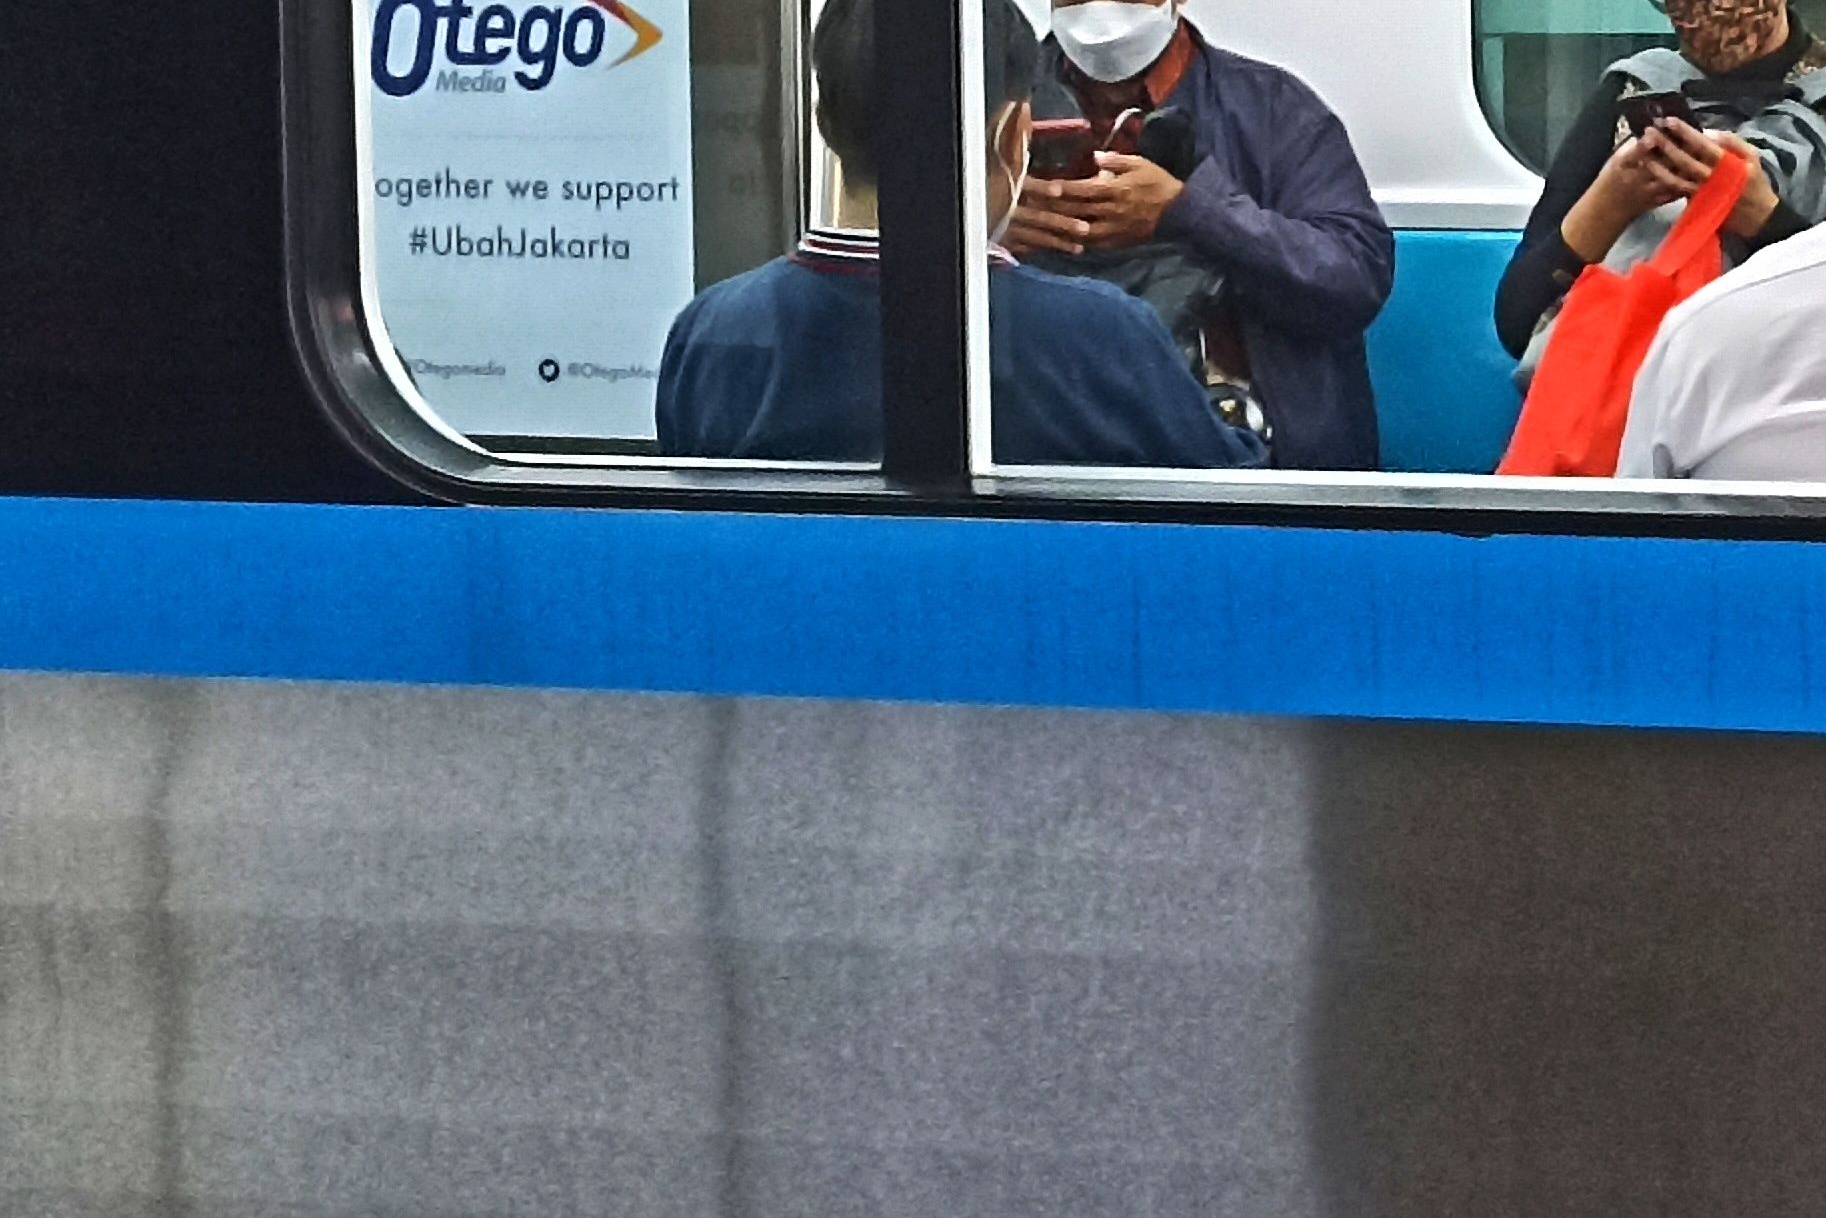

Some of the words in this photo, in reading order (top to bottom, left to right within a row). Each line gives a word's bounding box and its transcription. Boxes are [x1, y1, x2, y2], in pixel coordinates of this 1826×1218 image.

[435, 69, 506, 93] Media
[375, 168, 493, 206] ogether
[505, 180, 549, 199] we
[562, 177, 679, 210] support
[409, 224, 630, 260] #UbahJakarta
